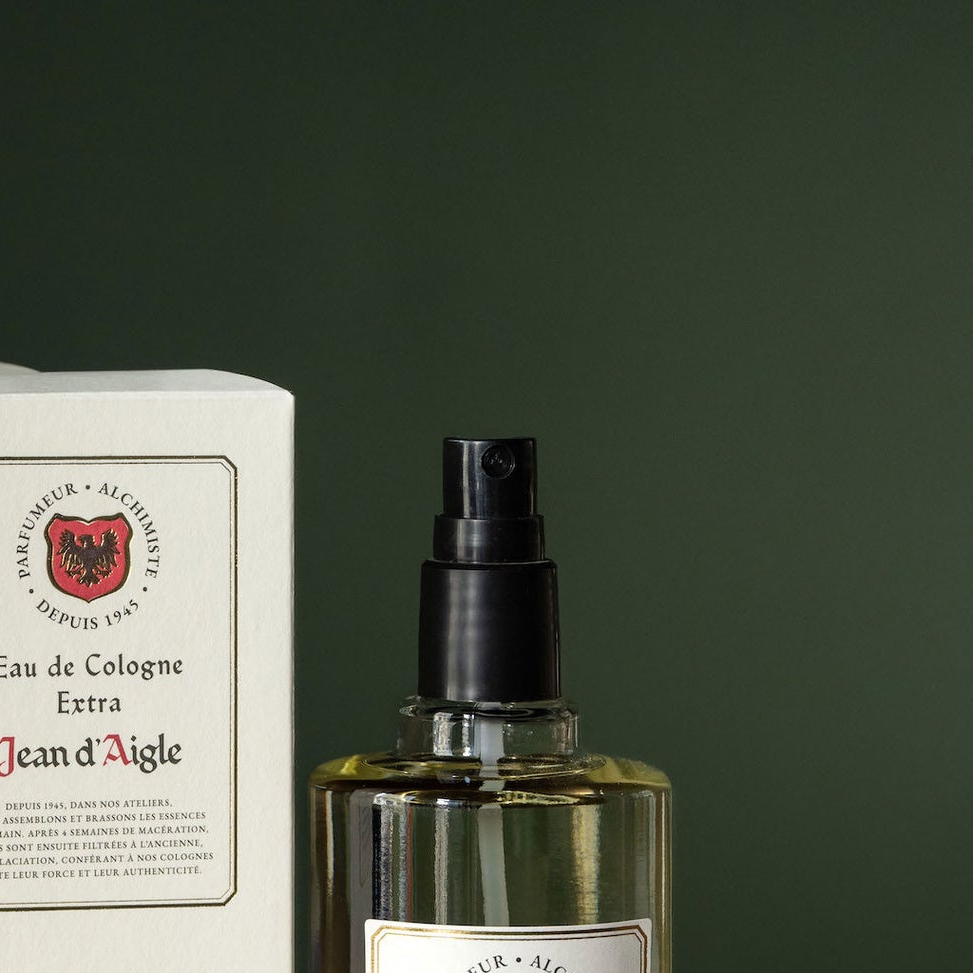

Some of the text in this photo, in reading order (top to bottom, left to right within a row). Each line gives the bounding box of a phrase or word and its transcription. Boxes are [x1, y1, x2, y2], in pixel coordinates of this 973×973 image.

[16, 483, 78, 579] PARFUMEUR
[99, 483, 160, 579] ALCHIMISTE
[36, 599, 138, 629] DEPUIS 1945
[48, 655, 74, 677] de
[85, 654, 182, 680] Cologne
[58, 691, 121, 715] Extra
[75, 733, 182, 774] d'Aigle
[6, 799, 172, 810] DEPUIS 1945, DANS NOS ATELIERS,
[2, 816, 67, 824] ASSEMBLONS
[70, 815, 83, 823] ET
[86, 813, 136, 822] BRASSONS
[139, 813, 156, 821] LES
[159, 812, 206, 820] ESSENCES
[28, 828, 59, 838] APRÈS
[62, 829, 67, 837] 4
[70, 827, 119, 836] SEMAINES
[123, 827, 135, 835] DE
[139, 825, 208, 834] MACÉRATION,
[6, 843, 33, 852] SONT
[37, 842, 79, 851] ENSUITE
[83, 840, 127, 850] FILTRÉES
[130, 839, 136, 848] À
[140, 839, 203, 848] L'ANCIENNE,
[61, 854, 124, 864] CONFÉRANT
[127, 853, 134, 862] À
[137, 854, 157, 862] NOS
[160, 852, 213, 861] COLOGNES
[13, 871, 38, 879] LEUR
[42, 870, 75, 878] FORCE
[79, 869, 91, 877] ET
[94, 869, 119, 877] LEUR
[123, 865, 201, 876] AUTHENTICITÉ.
